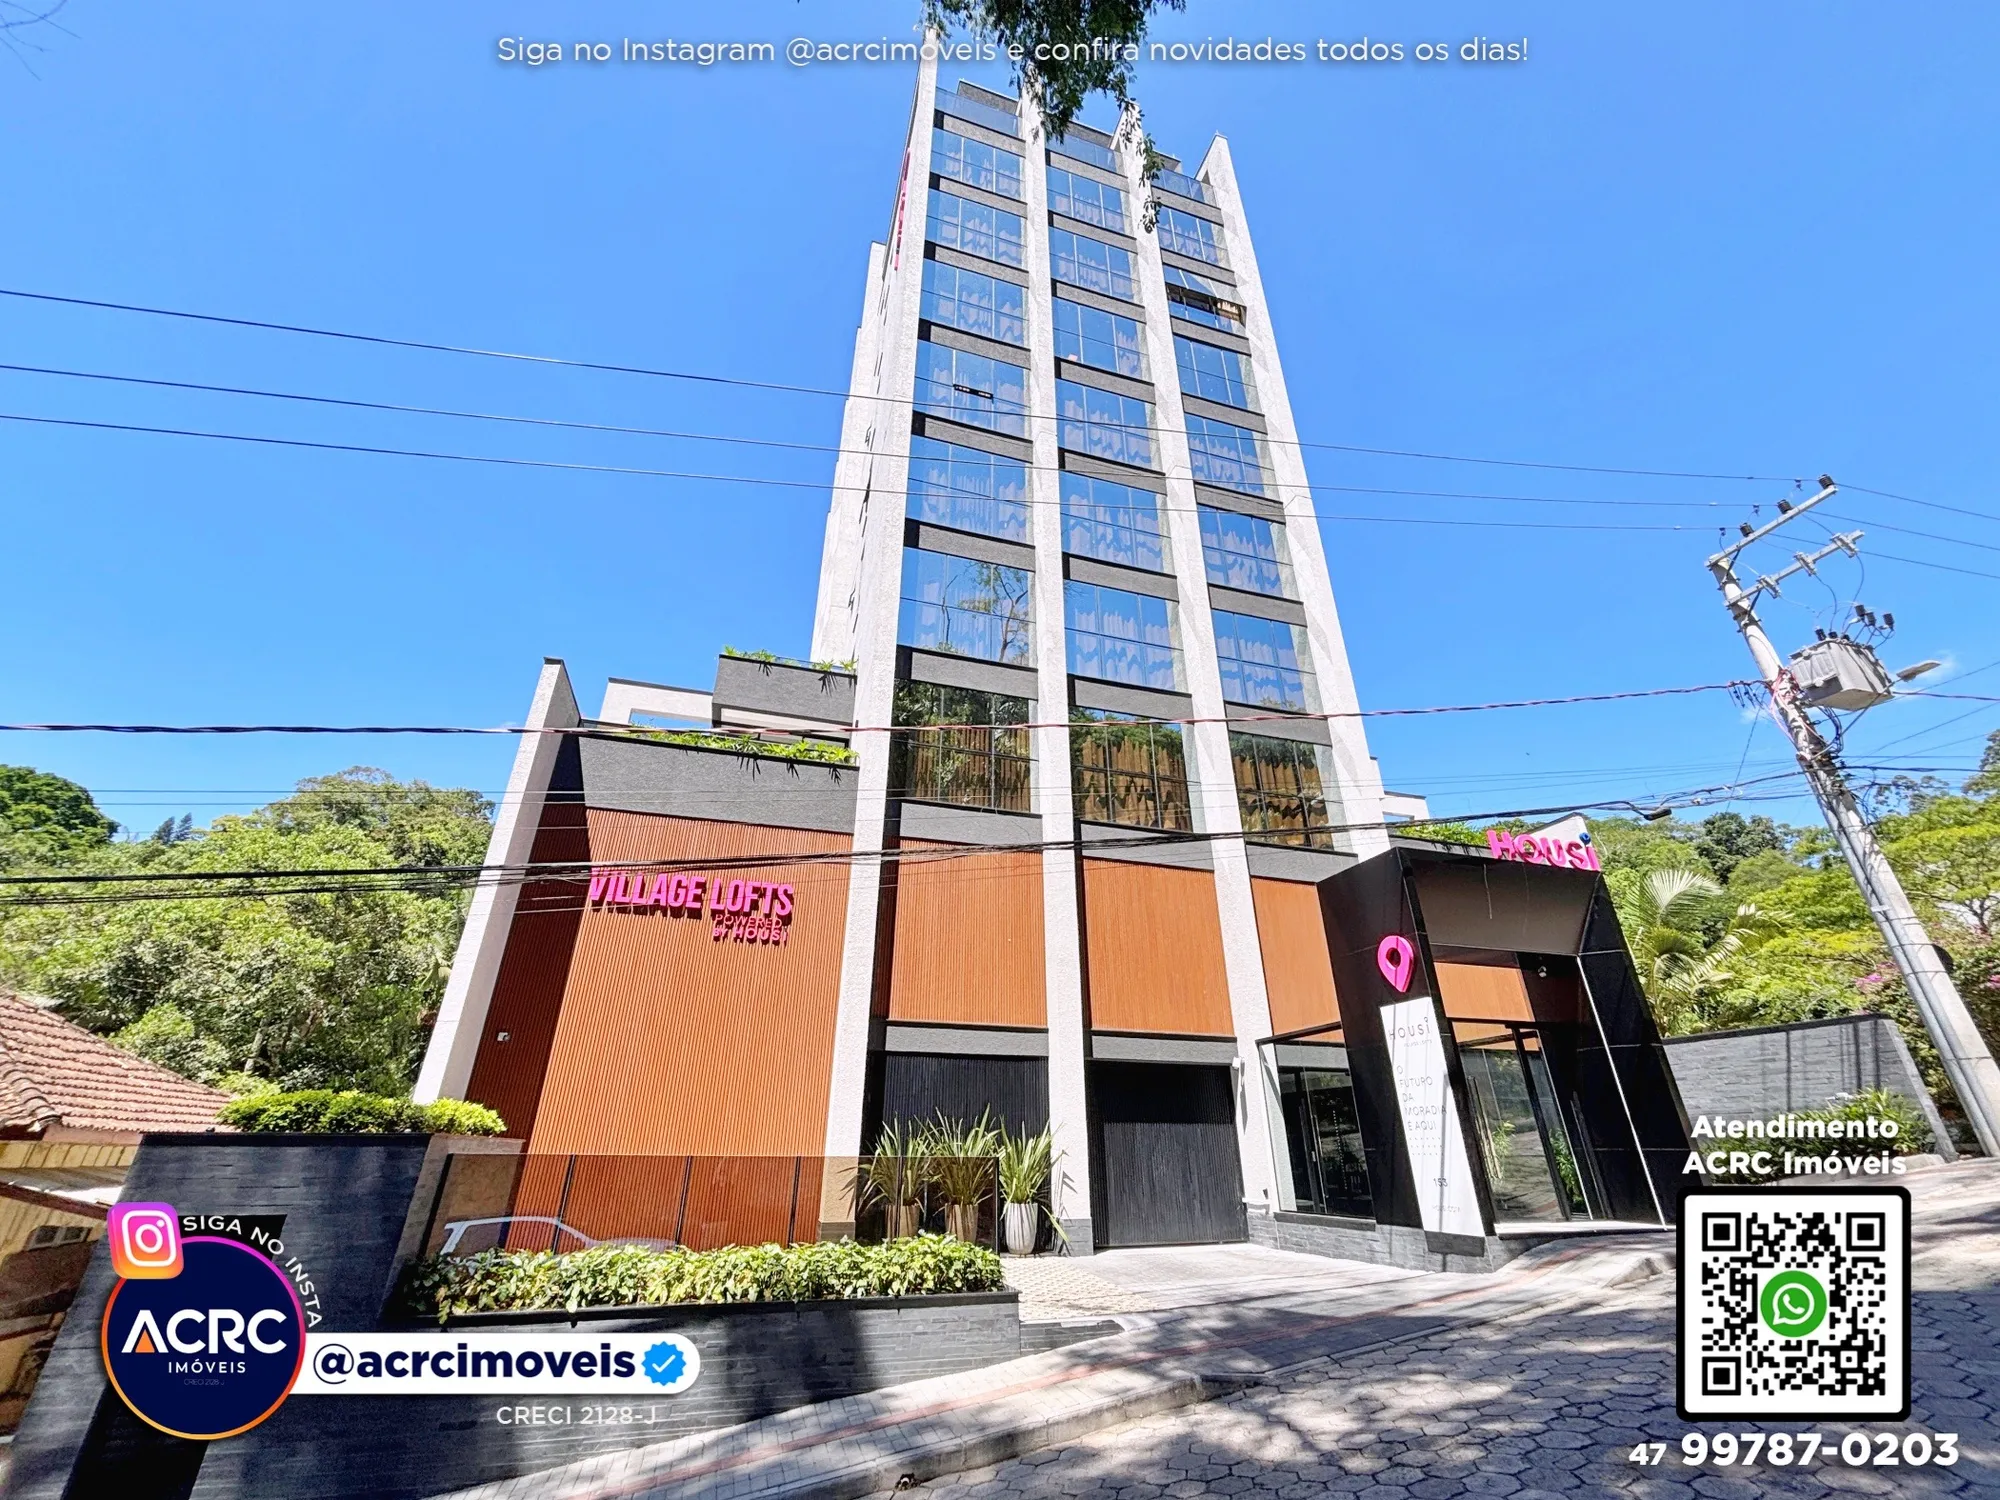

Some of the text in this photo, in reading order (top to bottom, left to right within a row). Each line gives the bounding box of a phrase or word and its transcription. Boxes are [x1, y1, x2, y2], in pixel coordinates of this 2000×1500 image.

[590, 867, 794, 916] VILLAGE LOFTS
[715, 913, 783, 929] POWERED
[712, 927, 728, 938] BY
[1399, 1075, 1434, 1089] FUTURO
[1402, 1092, 1415, 1103] DA
[1404, 1104, 1448, 1117] MORADIA
[1415, 1120, 1437, 1131] AQUI
